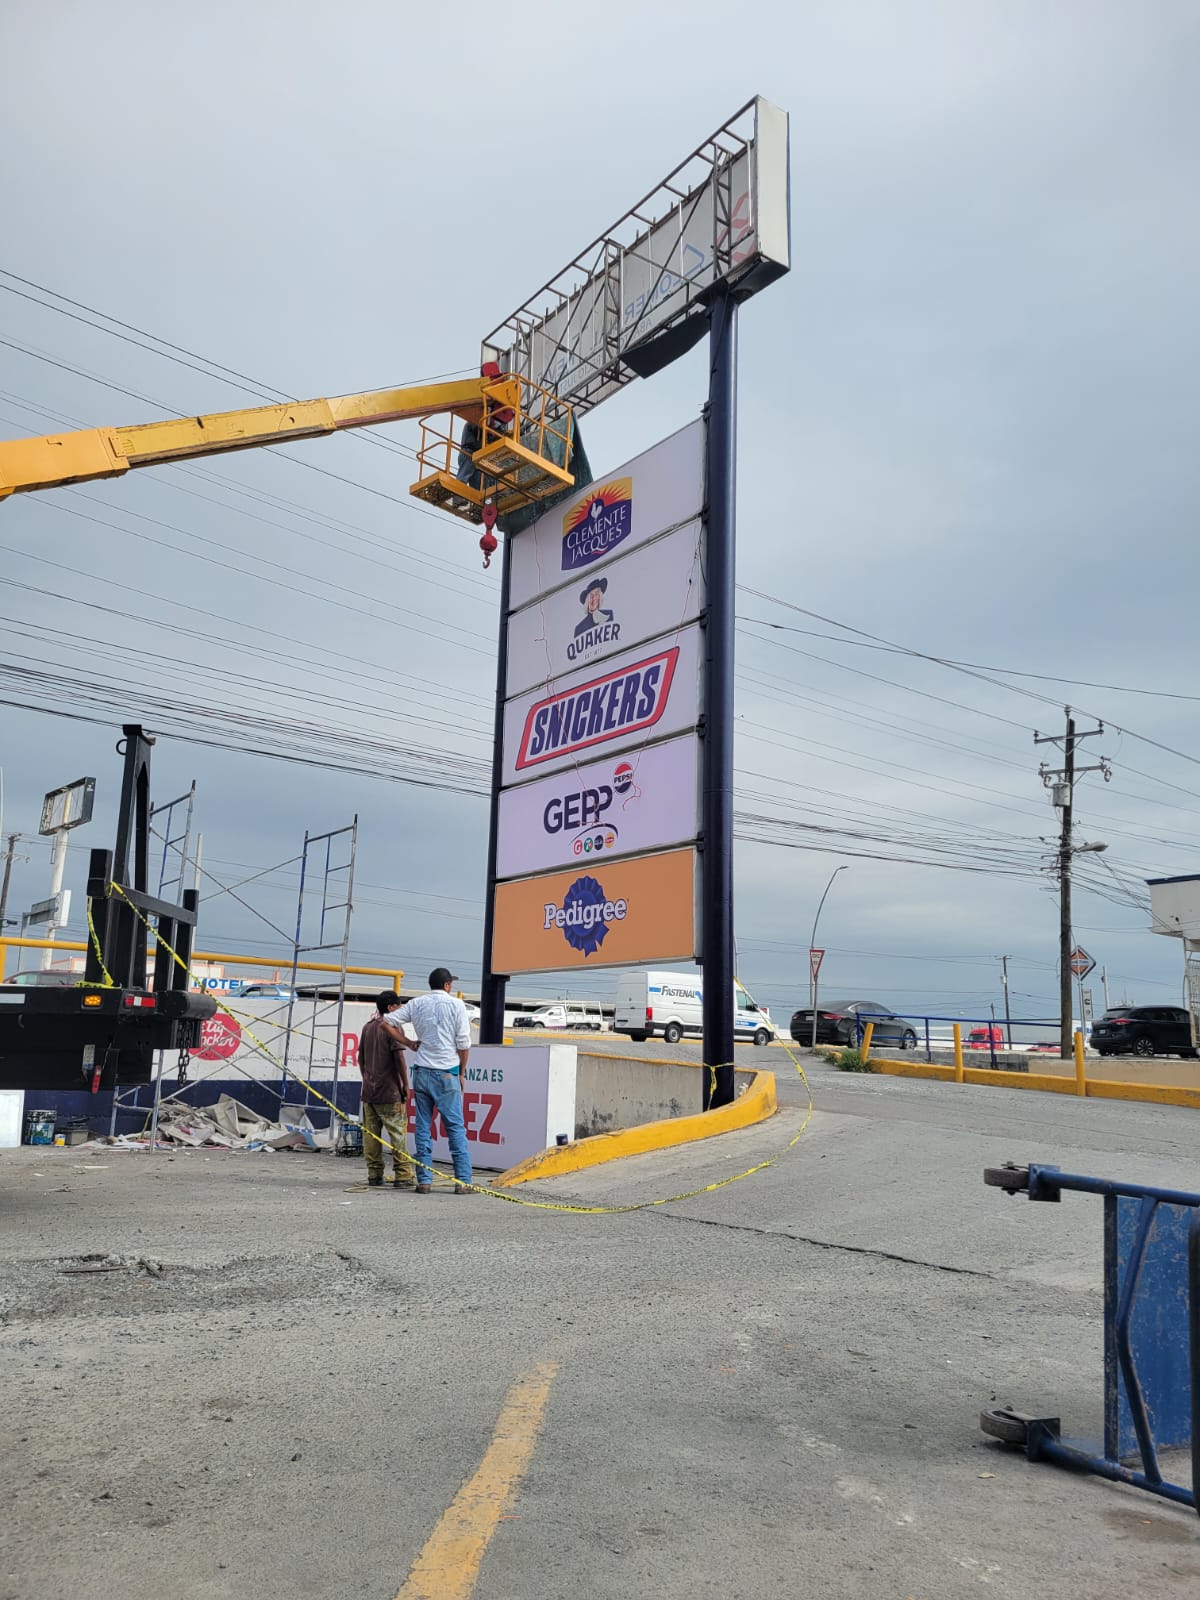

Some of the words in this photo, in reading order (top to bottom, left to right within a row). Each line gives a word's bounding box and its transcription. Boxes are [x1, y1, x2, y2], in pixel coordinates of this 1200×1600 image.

[567, 504, 626, 549] CLEMENTE
[571, 523, 622, 565] JACQUES
[567, 623, 620, 660] QUAKER
[530, 665, 661, 756] SNICKERS
[613, 772, 633, 784] PEPSI
[544, 785, 613, 834] GEPP
[544, 898, 628, 930] Pedigree
[491, 1069, 504, 1083] ES
